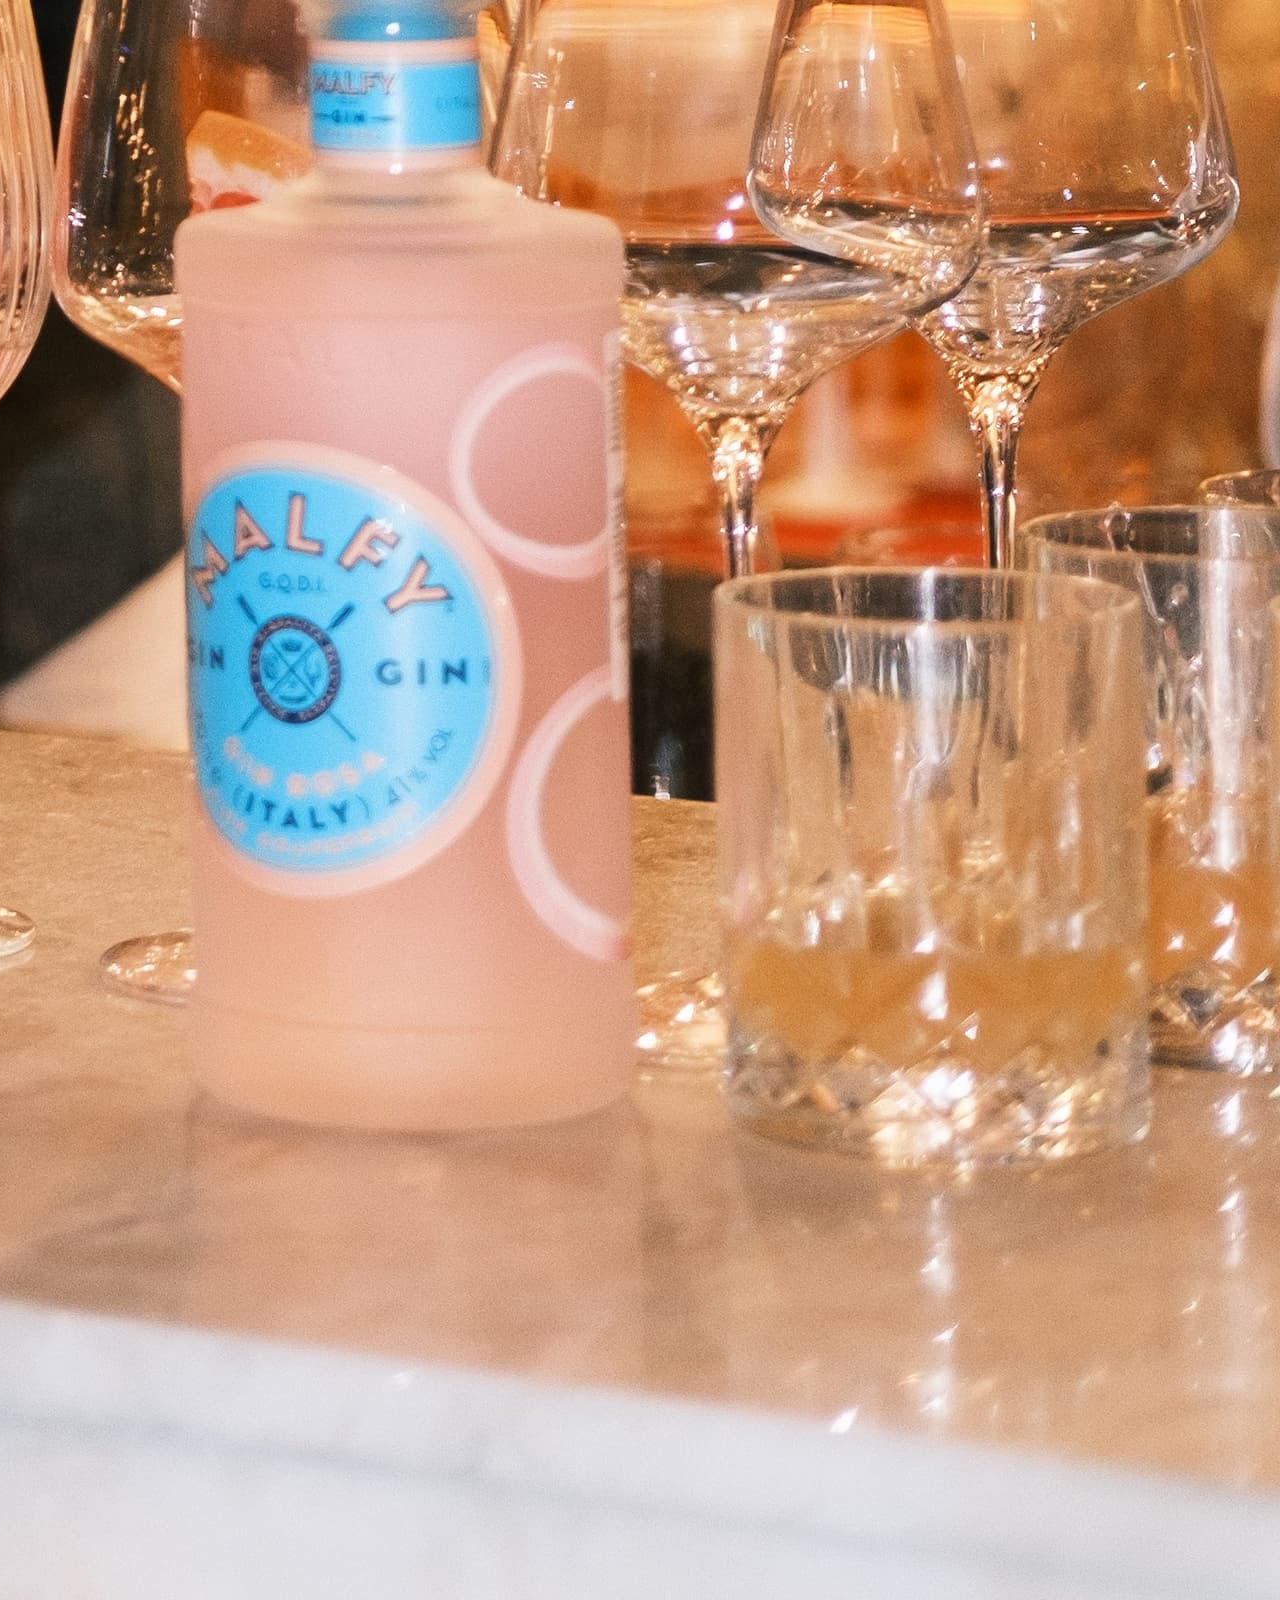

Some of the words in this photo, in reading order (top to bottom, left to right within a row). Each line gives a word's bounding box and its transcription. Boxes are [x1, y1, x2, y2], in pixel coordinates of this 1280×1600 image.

[189, 491, 454, 615] MALFY
[375, 658, 468, 687] GIN
[232, 784, 372, 831] (ITALY)
